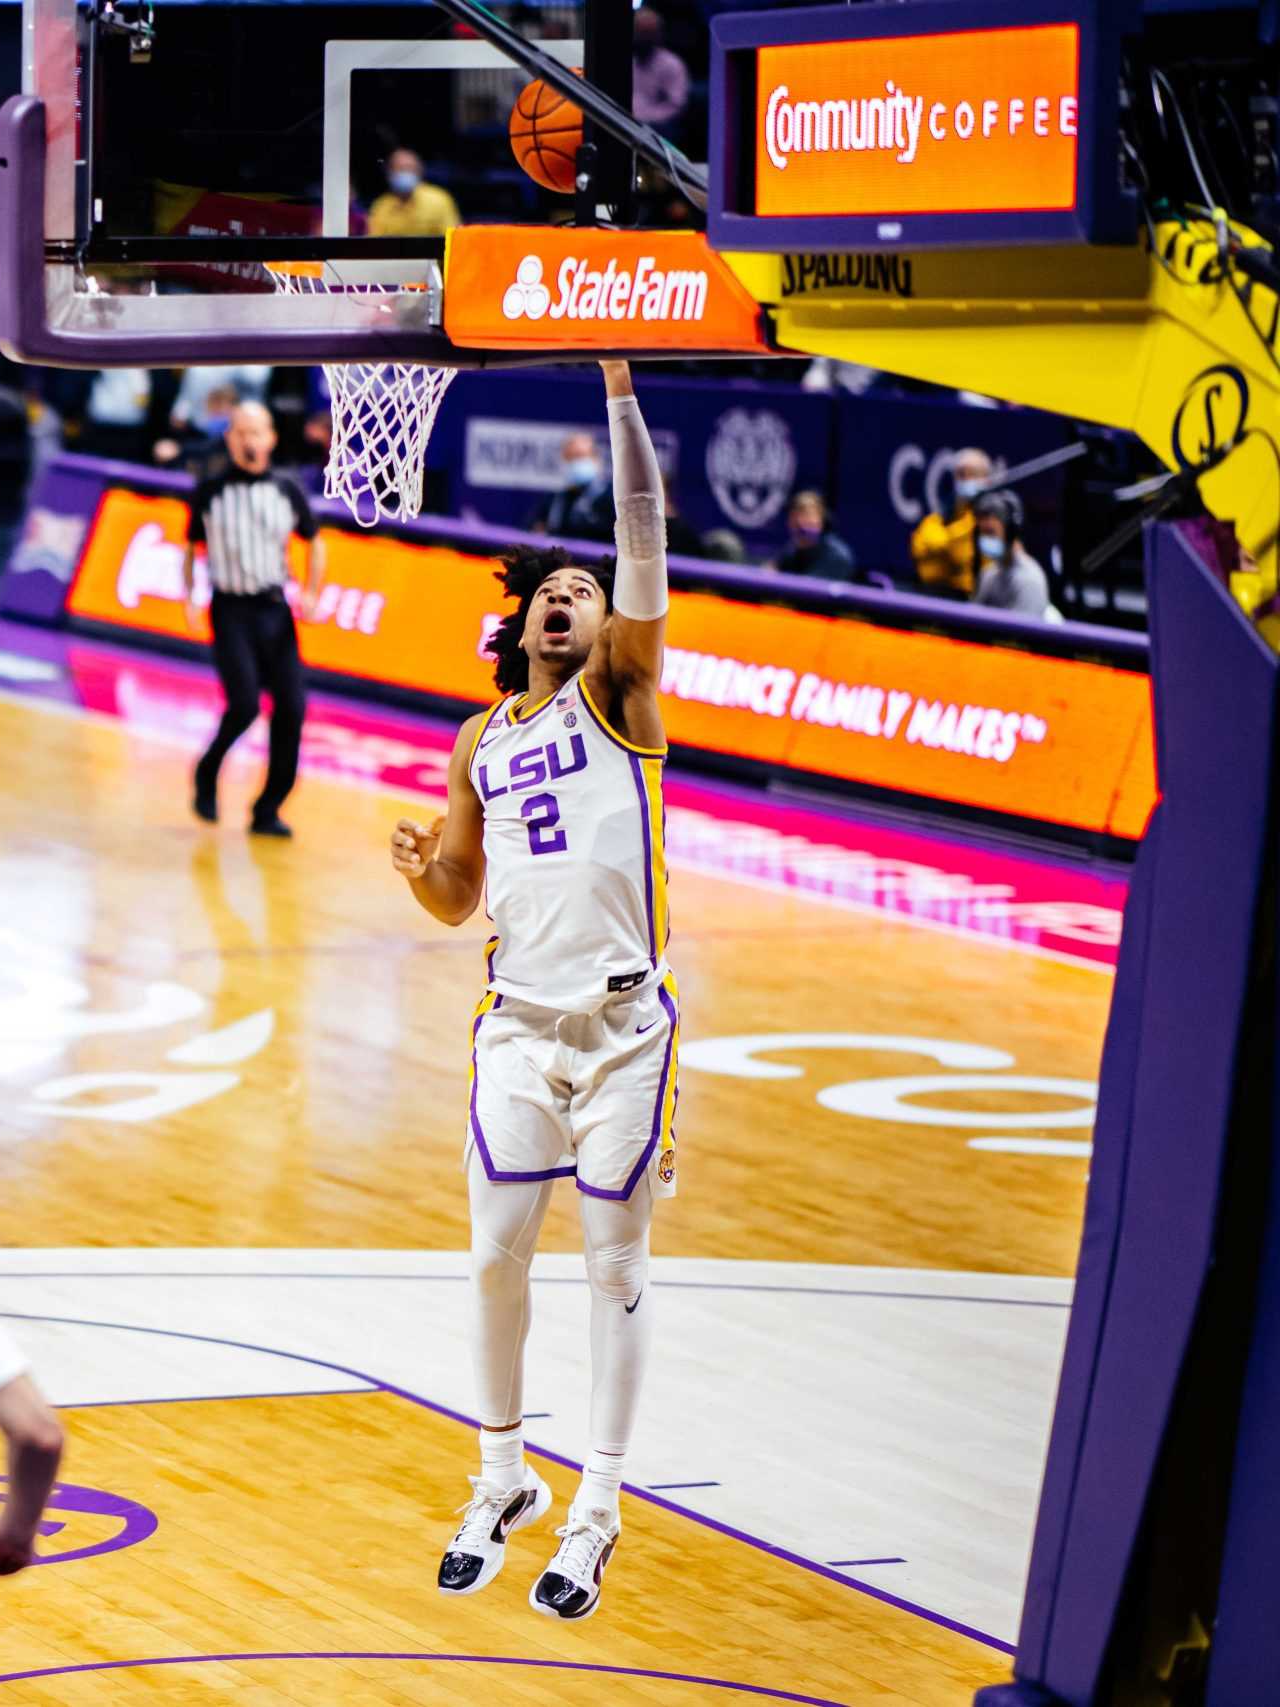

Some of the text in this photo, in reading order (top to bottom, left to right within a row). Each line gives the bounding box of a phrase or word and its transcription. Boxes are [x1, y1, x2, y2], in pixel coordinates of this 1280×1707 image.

[766, 80, 1078, 170] Community COFFEE
[781, 253, 913, 298] SPALDING
[659, 646, 797, 718] FERENCE
[790, 672, 912, 739] FAMILY
[478, 732, 589, 802] LSU
[520, 792, 568, 856] 2
